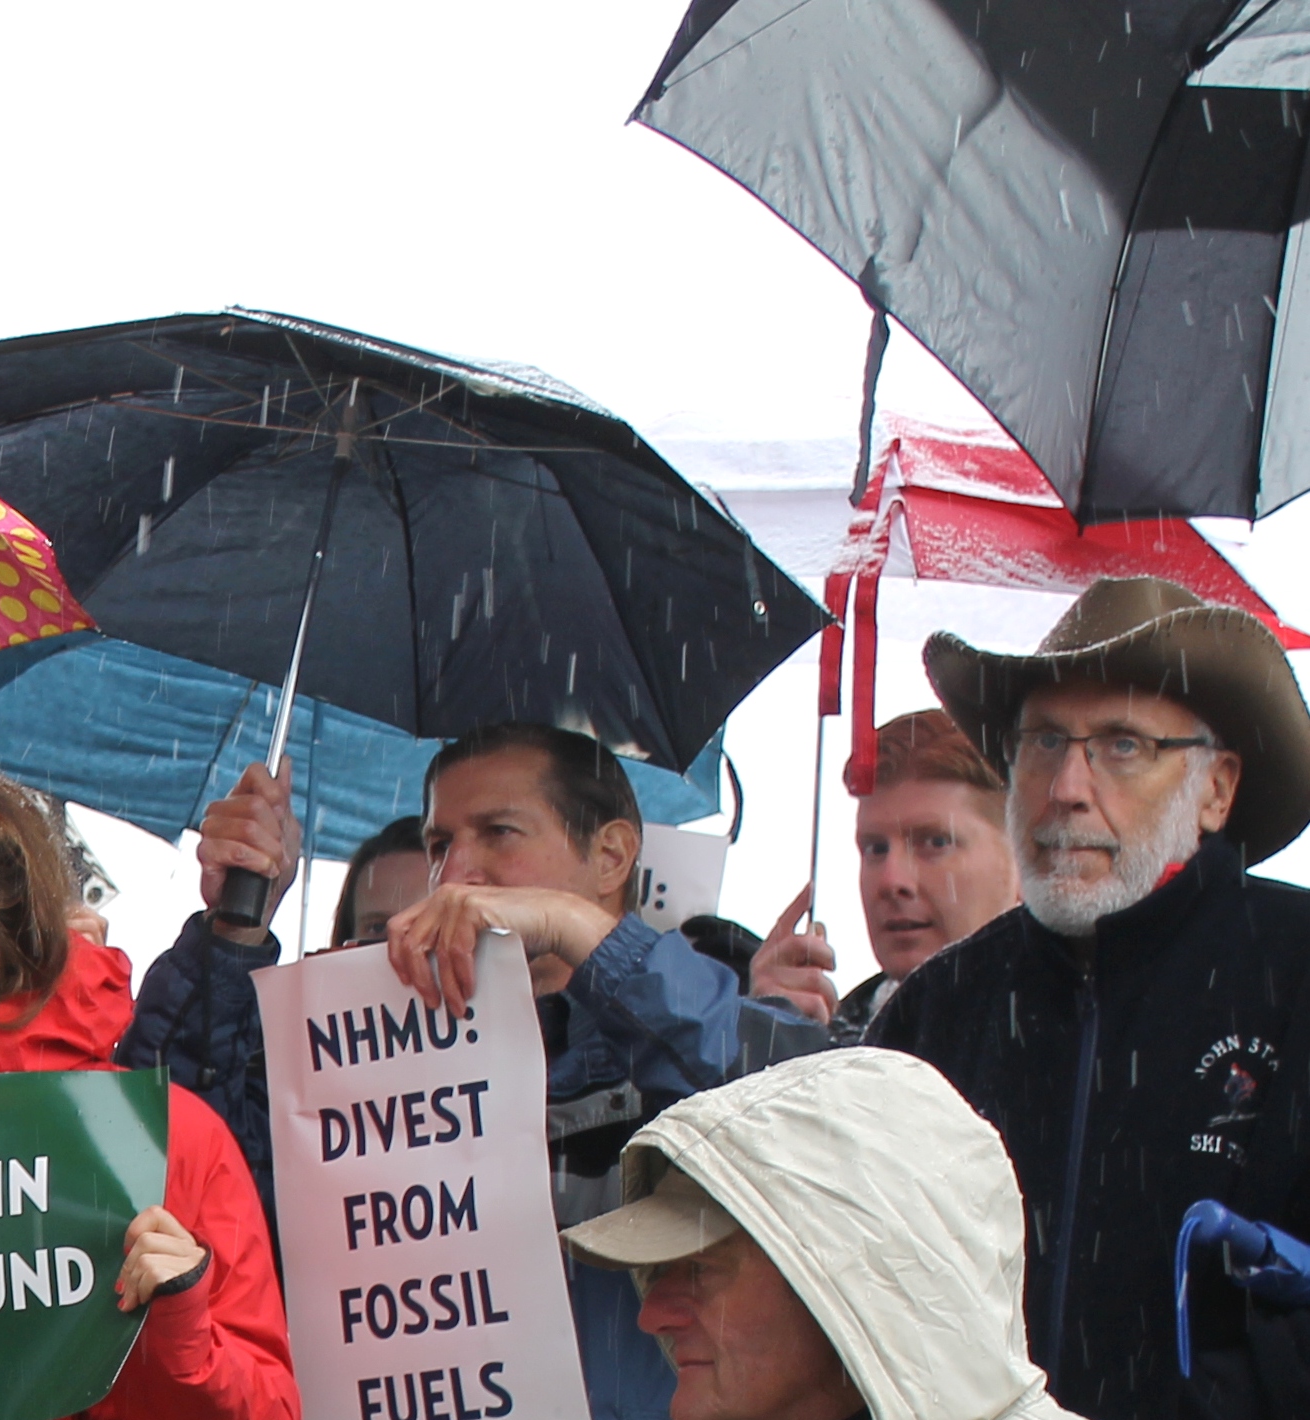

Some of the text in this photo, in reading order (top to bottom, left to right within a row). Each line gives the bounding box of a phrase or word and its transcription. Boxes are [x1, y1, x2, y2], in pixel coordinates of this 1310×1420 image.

[306, 998, 479, 1072] NHMU:
[317, 1080, 490, 1163] DIVEST
[1190, 1134, 1222, 1153] SKI
[342, 1175, 479, 1251] FROM
[338, 1268, 510, 1344] FOSSIL
